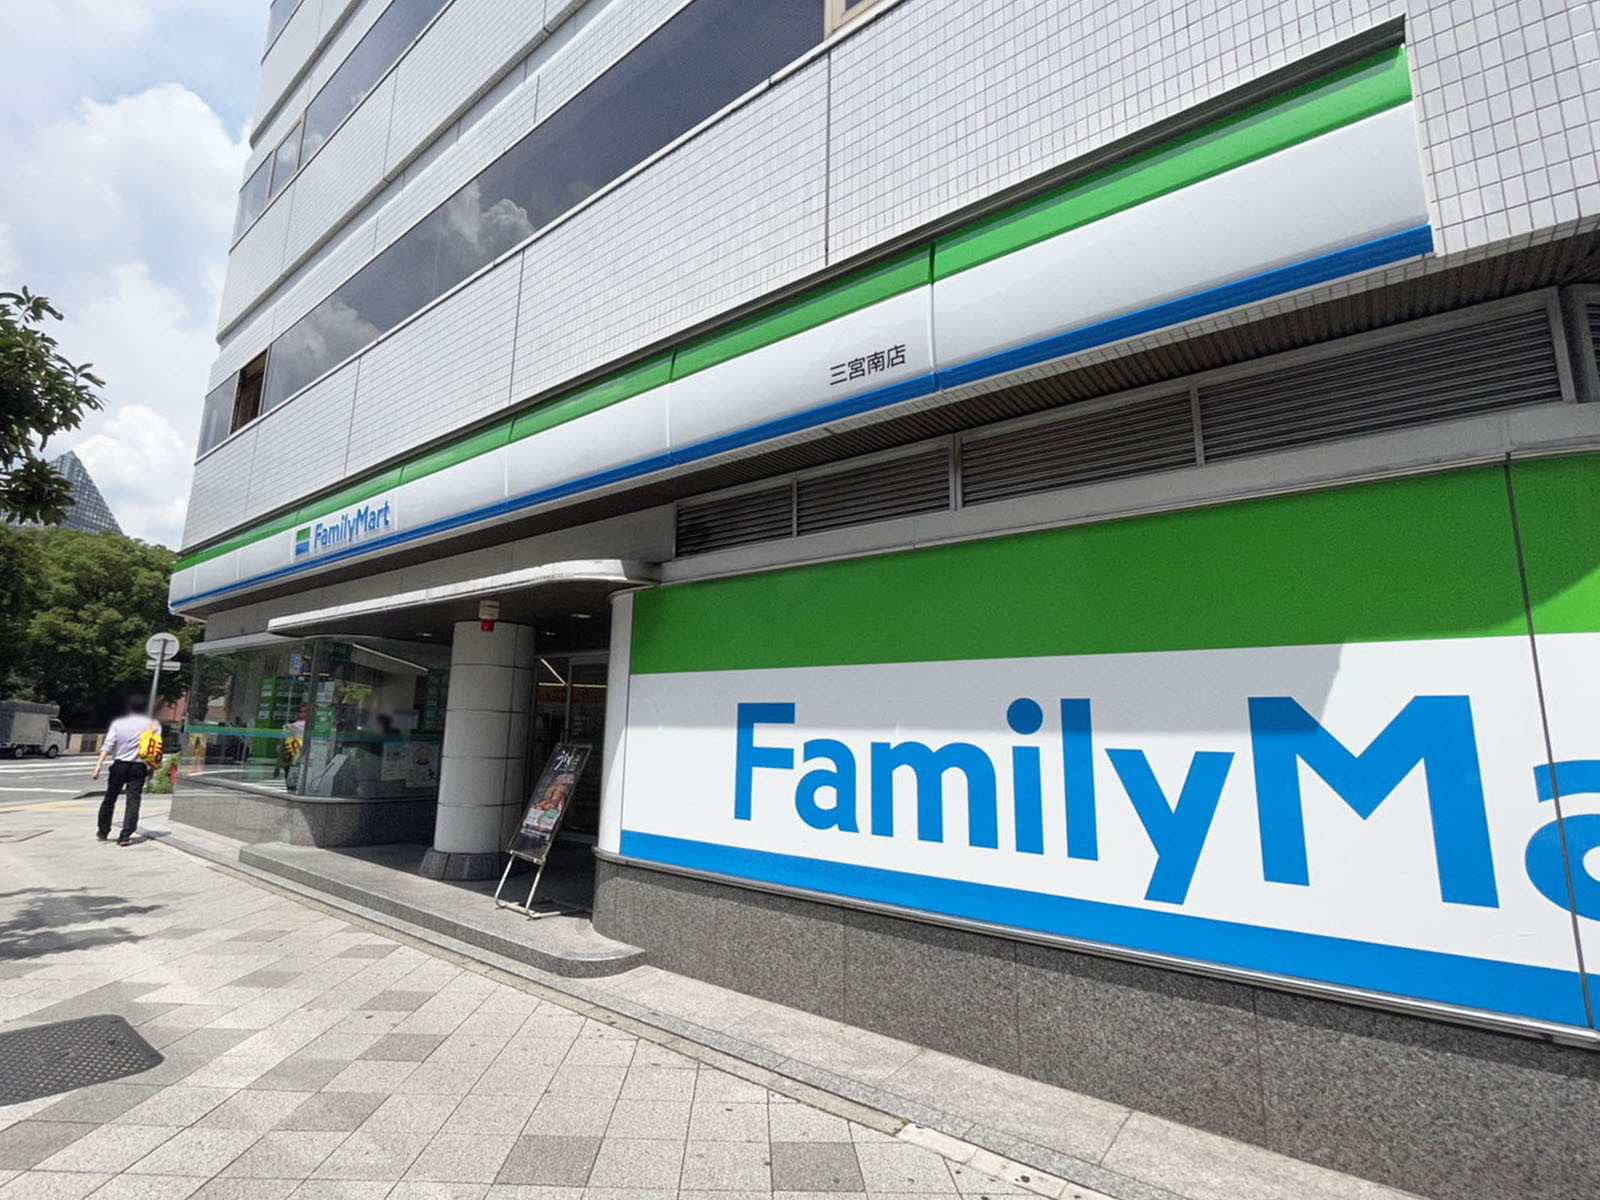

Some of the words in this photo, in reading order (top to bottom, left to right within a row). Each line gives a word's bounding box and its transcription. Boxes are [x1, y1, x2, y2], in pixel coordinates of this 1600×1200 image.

[829, 344, 906, 386] 三宮南店
[314, 500, 390, 549] FamilyMart
